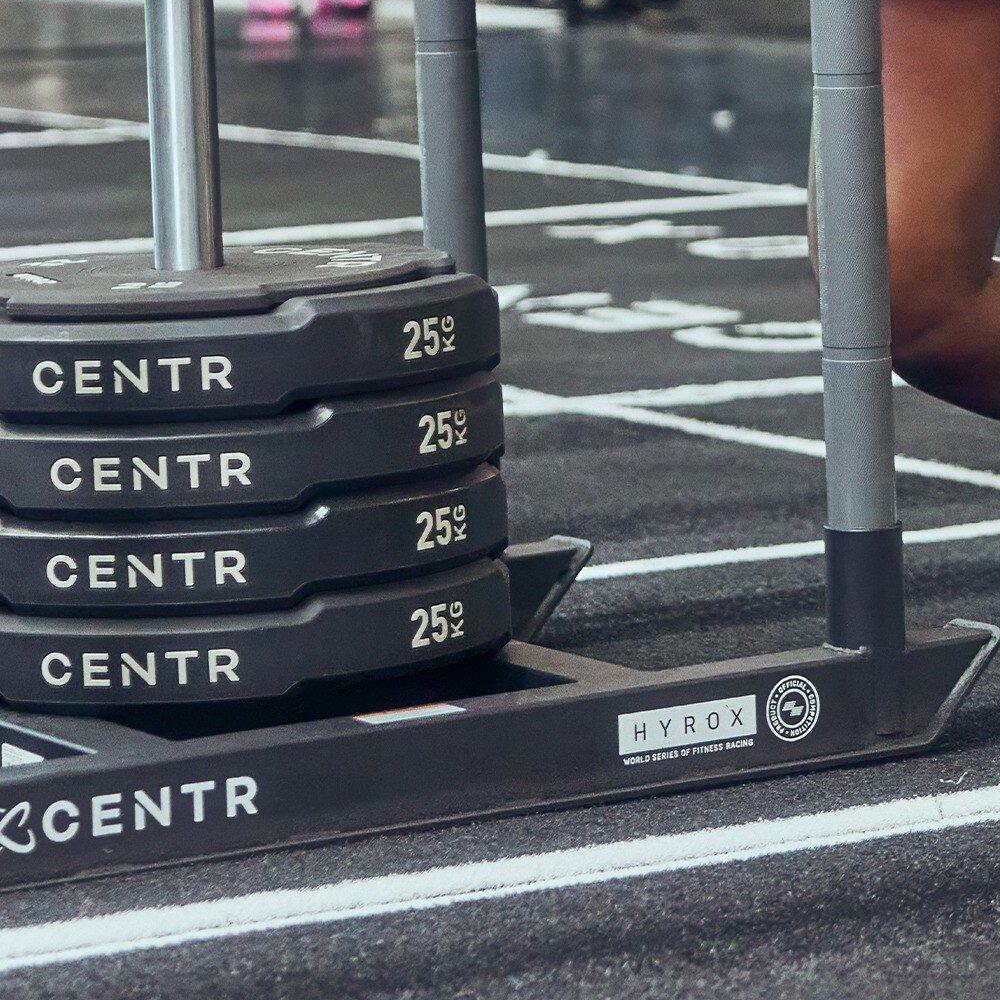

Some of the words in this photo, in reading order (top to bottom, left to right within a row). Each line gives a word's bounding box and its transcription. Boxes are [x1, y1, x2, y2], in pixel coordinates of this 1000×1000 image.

[403, 317, 440, 360] 25
[441, 315, 456, 352] KG
[33, 356, 233, 394] CENTR
[418, 410, 453, 454] 25
[454, 408, 468, 446] KG
[50, 452, 251, 491] CENTR
[416, 506, 451, 551] 25
[453, 504, 467, 541] KG
[46, 551, 247, 589] CENTR
[410, 603, 449, 648] 25
[450, 600, 465, 638] KG
[41, 649, 240, 687] CENTR
[778, 680, 807, 694] OFFICIAL
[634, 707, 744, 742] HYROX
[770, 699, 785, 734] PRODUCT
[790, 693, 816, 736] COMPETITION
[623, 754, 650, 766] WORLD
[651, 750, 679, 762] SERIES
[680, 746, 691, 757] OF
[692, 743, 724, 755] FITNESS
[725, 738, 754, 749] RACING
[42, 776, 258, 842] CENTR
